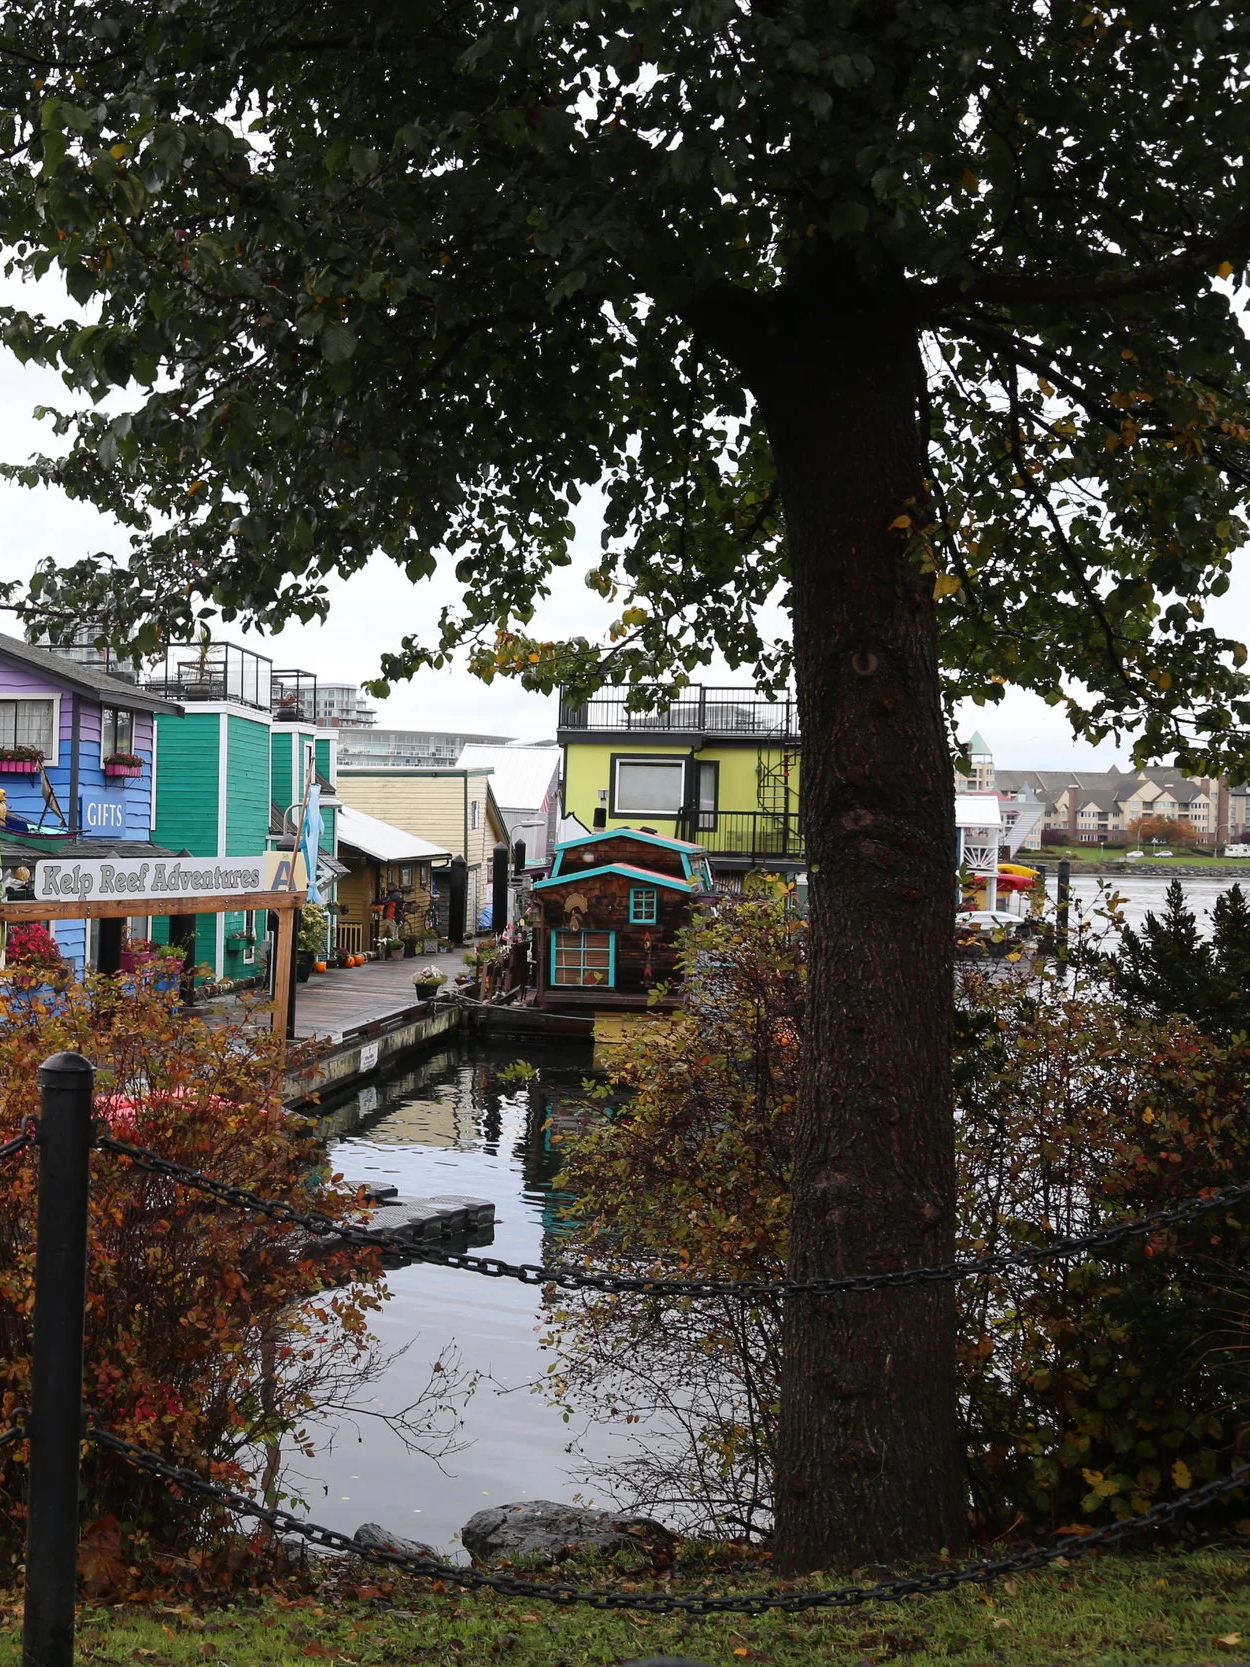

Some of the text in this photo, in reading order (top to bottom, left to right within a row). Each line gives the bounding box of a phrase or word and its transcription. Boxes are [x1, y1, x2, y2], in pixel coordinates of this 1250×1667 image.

[87, 802, 123, 827] GIFTS
[42, 862, 260, 900] Kelp Reef Adventures
[271, 860, 297, 891] A
